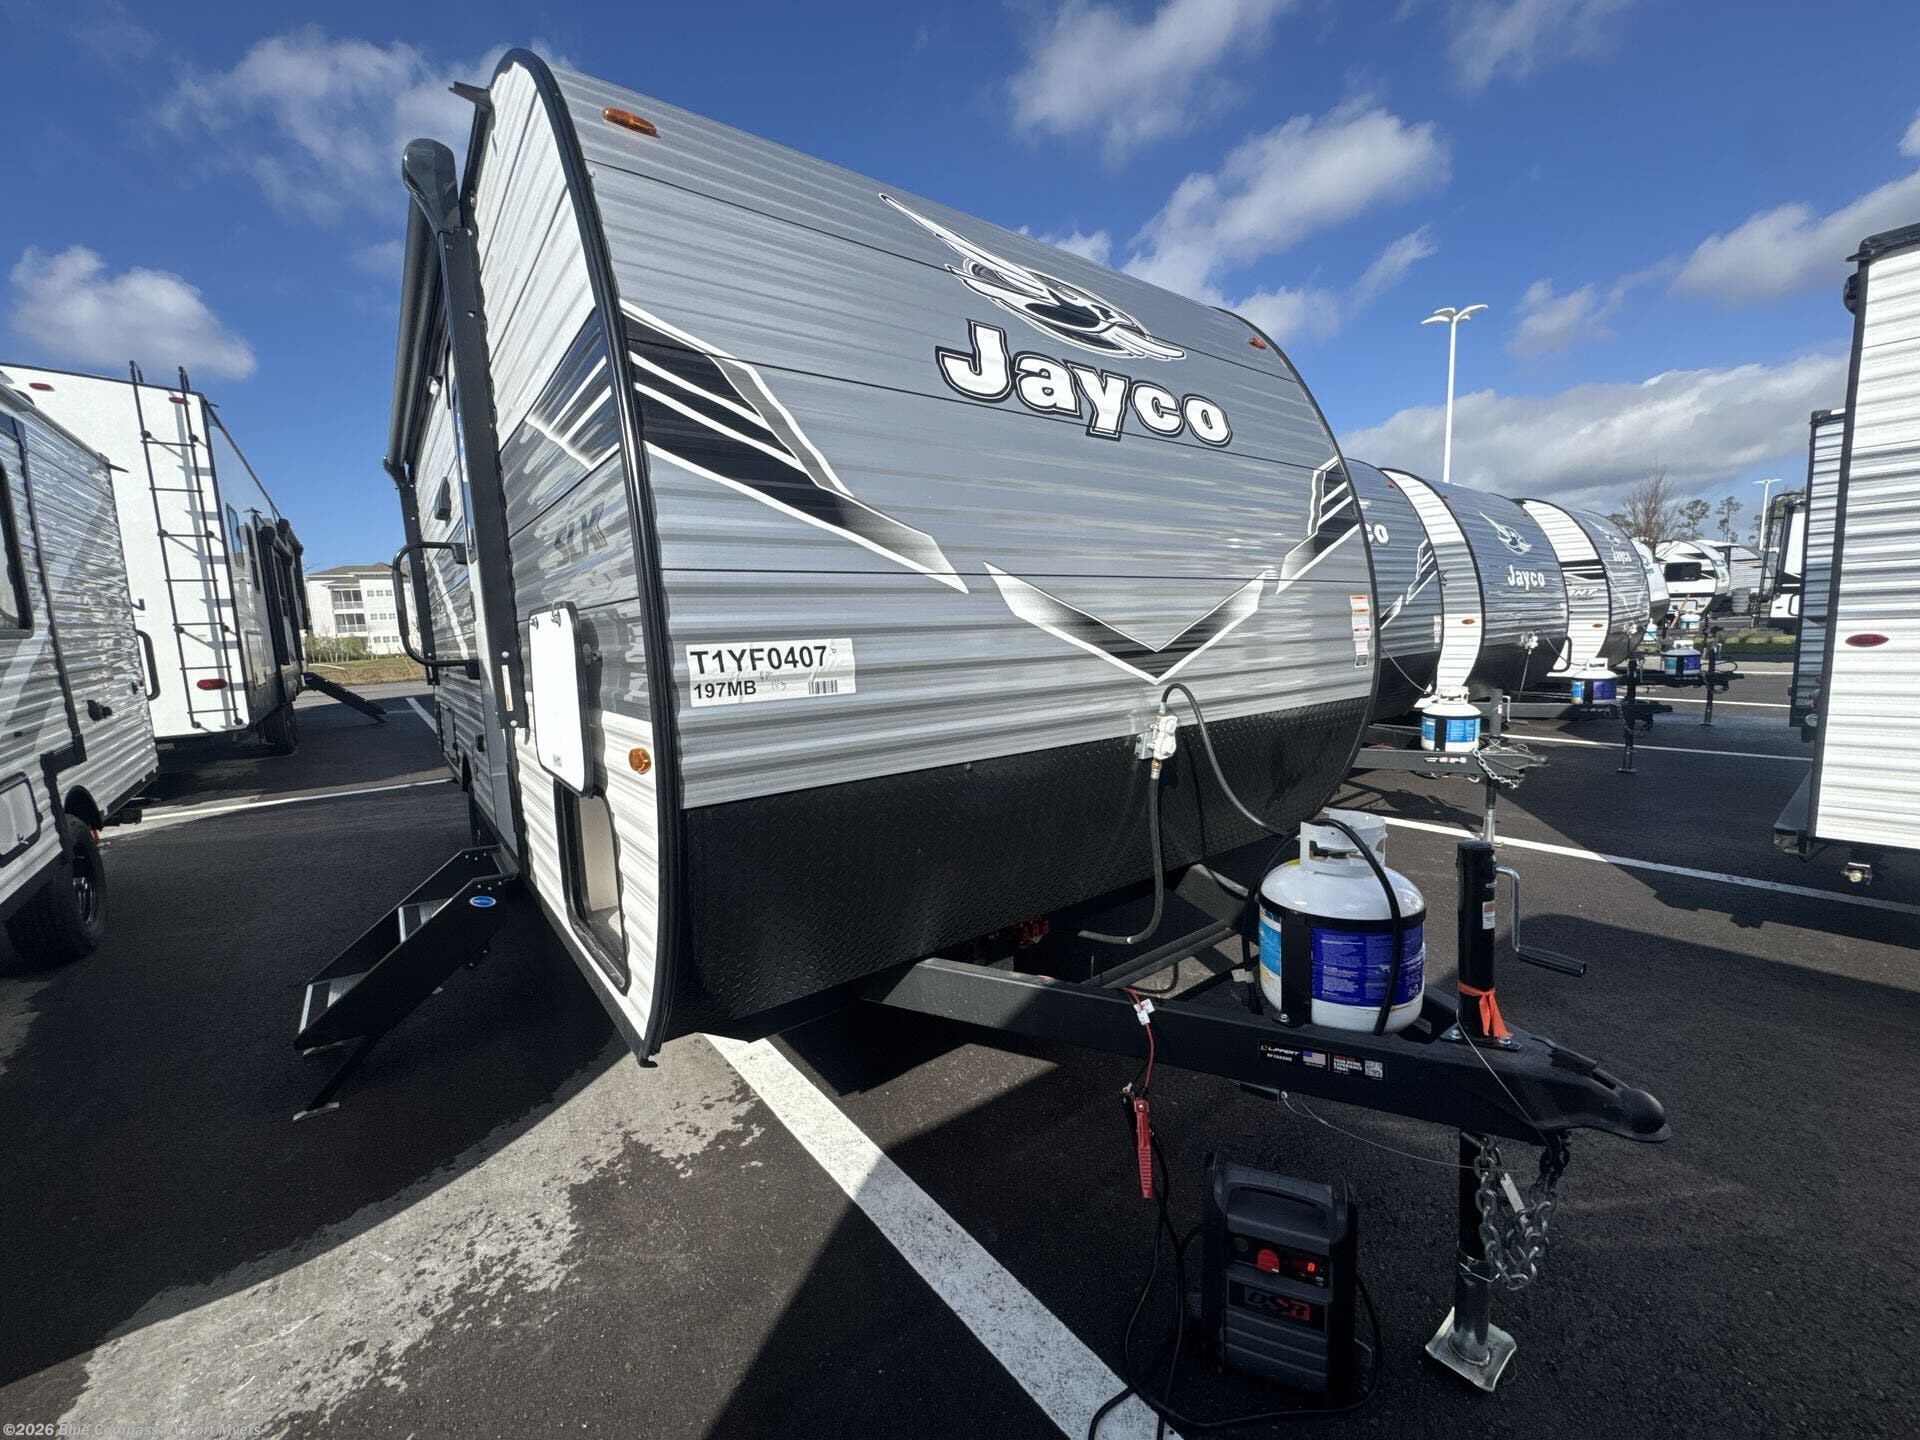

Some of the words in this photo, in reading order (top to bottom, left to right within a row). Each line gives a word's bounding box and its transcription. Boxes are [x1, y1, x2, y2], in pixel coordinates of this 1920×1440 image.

[935, 318, 1233, 447] Jayco
[1507, 564, 1546, 591] Jayco
[690, 645, 827, 675] T1YF0407
[694, 680, 757, 700] 197MB
